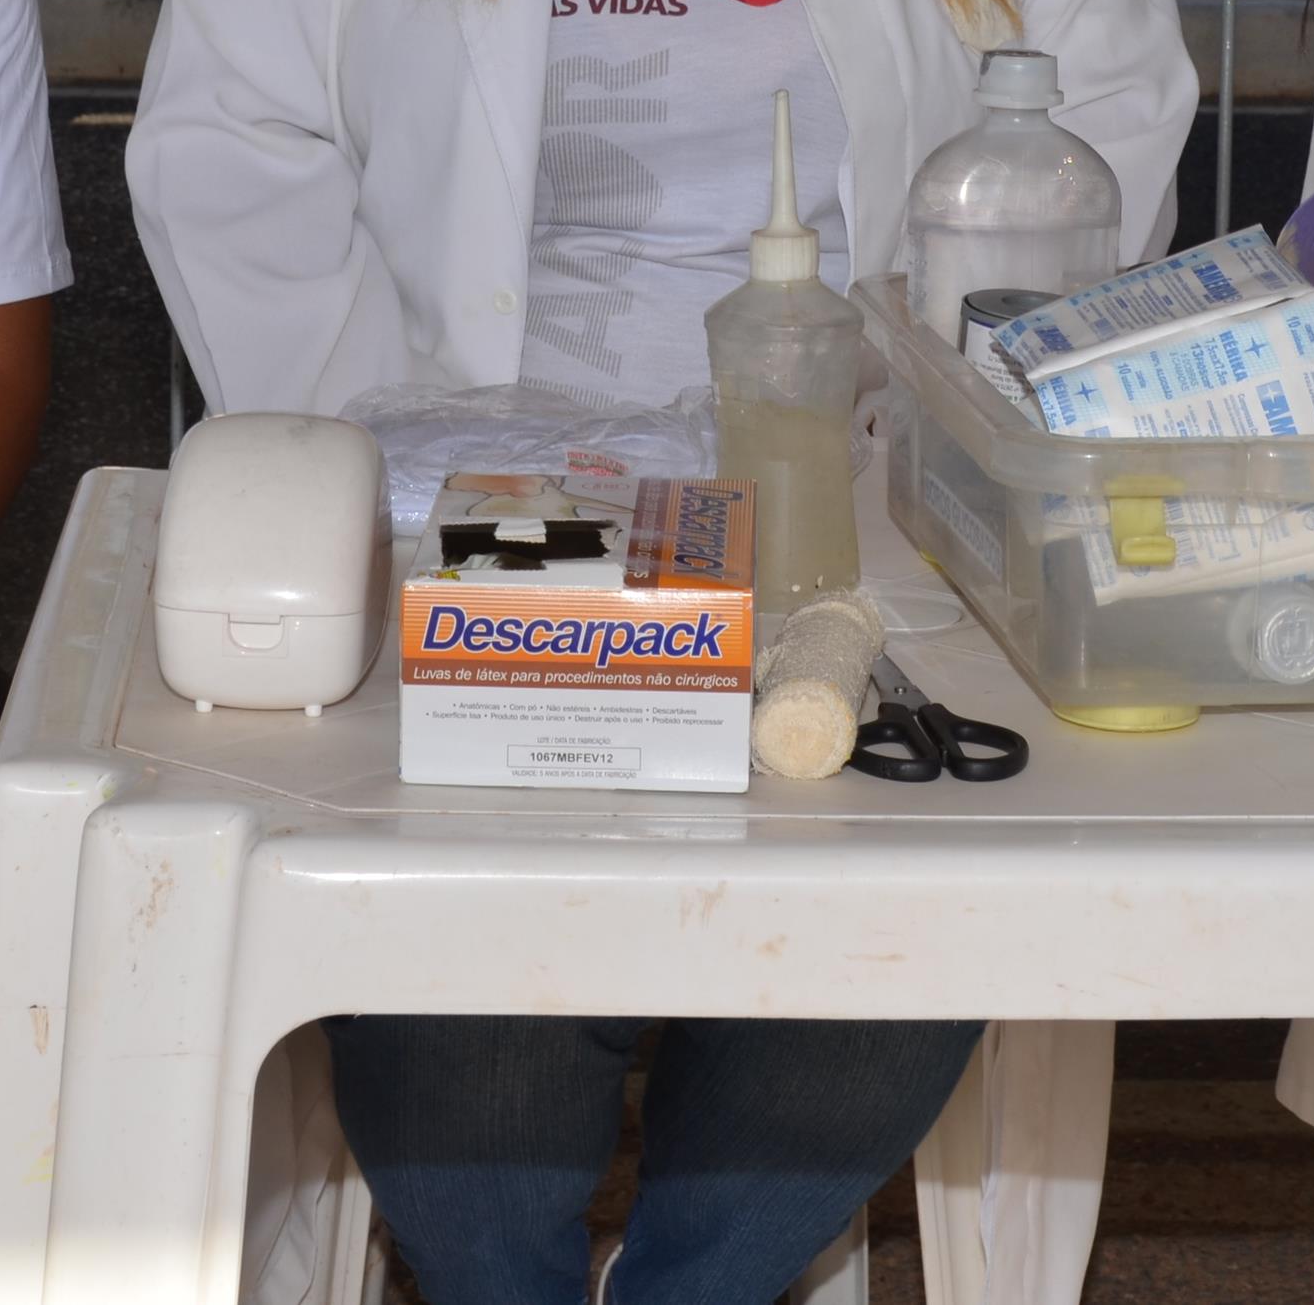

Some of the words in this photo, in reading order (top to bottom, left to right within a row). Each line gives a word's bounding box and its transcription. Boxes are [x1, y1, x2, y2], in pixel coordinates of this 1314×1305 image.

[1218, 329, 1249, 383] HÉRIKA
[1048, 375, 1078, 427] HÉRIKA
[422, 605, 730, 669] Descarpack
[413, 667, 451, 680] Luvas
[455, 668, 472, 681] de
[476, 668, 508, 682] látex
[510, 672, 541, 684] para
[544, 671, 643, 686] procedimentos
[645, 672, 672, 686] não
[675, 673, 739, 689] cirúrgicos
[530, 751, 614, 764] 1067MBFEV12
